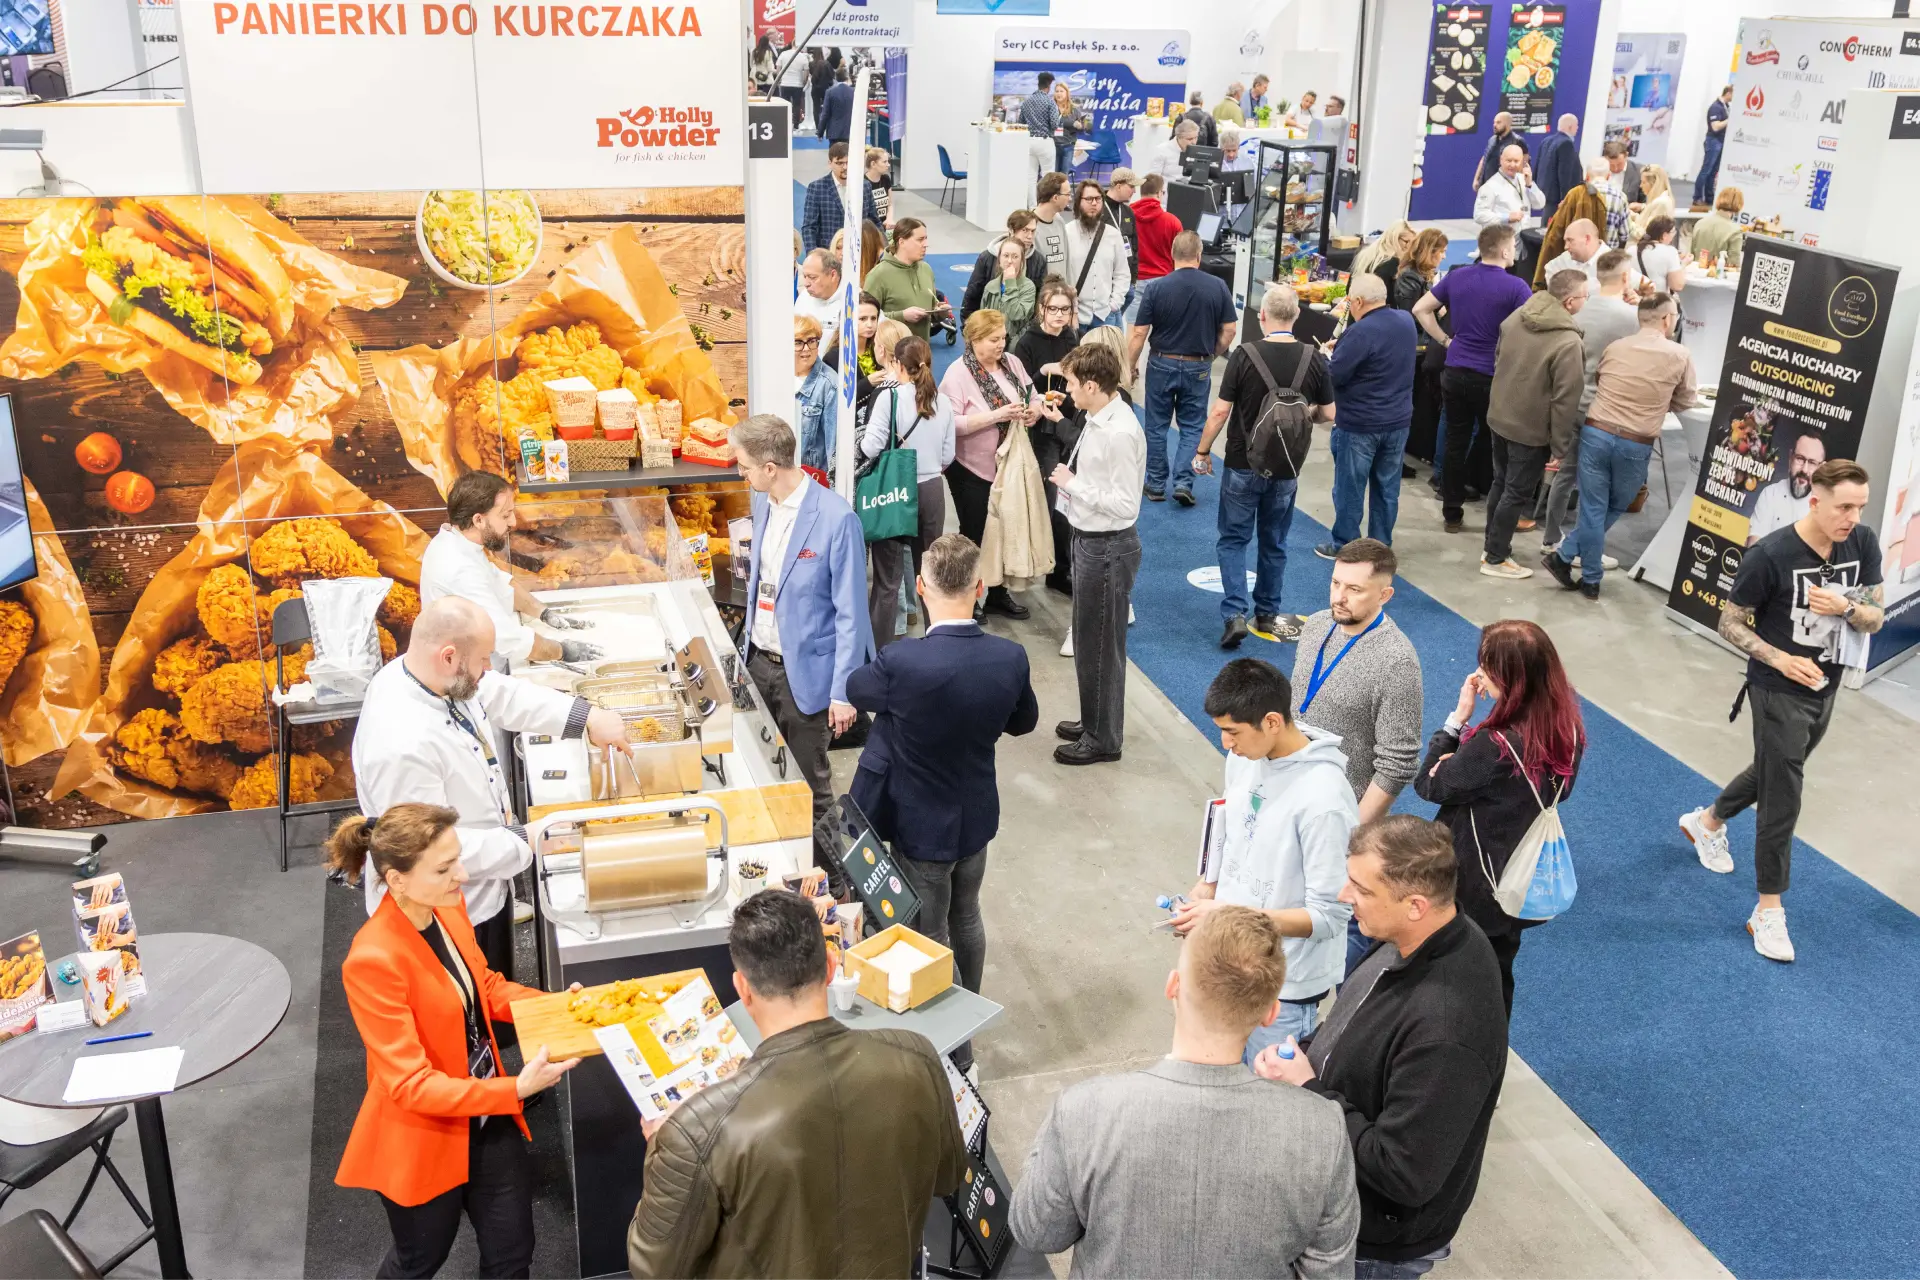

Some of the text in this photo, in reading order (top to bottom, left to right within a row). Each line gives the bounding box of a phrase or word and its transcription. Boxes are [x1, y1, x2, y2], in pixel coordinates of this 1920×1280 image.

[214, 3, 702, 37] PANIERKI DO KURCZAKA
[832, 12, 879, 23] Idź prosto
[842, 26, 900, 38] Kontraktacji
[1002, 39, 1026, 52] Sery
[1030, 40, 1049, 49] ICC
[1053, 40, 1087, 53] Pasłęk
[1091, 41, 1108, 53] Sp.
[1820, 40, 1892, 58] CONVOTHERM
[1068, 69, 1123, 97] Sery,
[1082, 92, 1141, 110] masła
[659, 107, 713, 127] Holly
[1100, 115, 1108, 130] i
[596, 118, 720, 147] Powder
[614, 152, 706, 164] for fish & chicken
[1738, 336, 1862, 384] AGENCJA KUCHARZY
[1750, 360, 1835, 397] OUTSOURCING
[1731, 372, 1852, 422] GASTRONOMICZNA OBSŁUGA EVENTÓW
[1800, 414, 1827, 431] catering
[1709, 461, 1736, 486] ZESPÓŁ
[1713, 445, 1775, 482] DOŚWIADCZONY
[862, 487, 909, 510] Local4
[1705, 479, 1746, 508] KUCHARZY
[1697, 589, 1717, 607] +48
[863, 859, 891, 895] CARTEL
[967, 1172, 985, 1220] CARTEL
